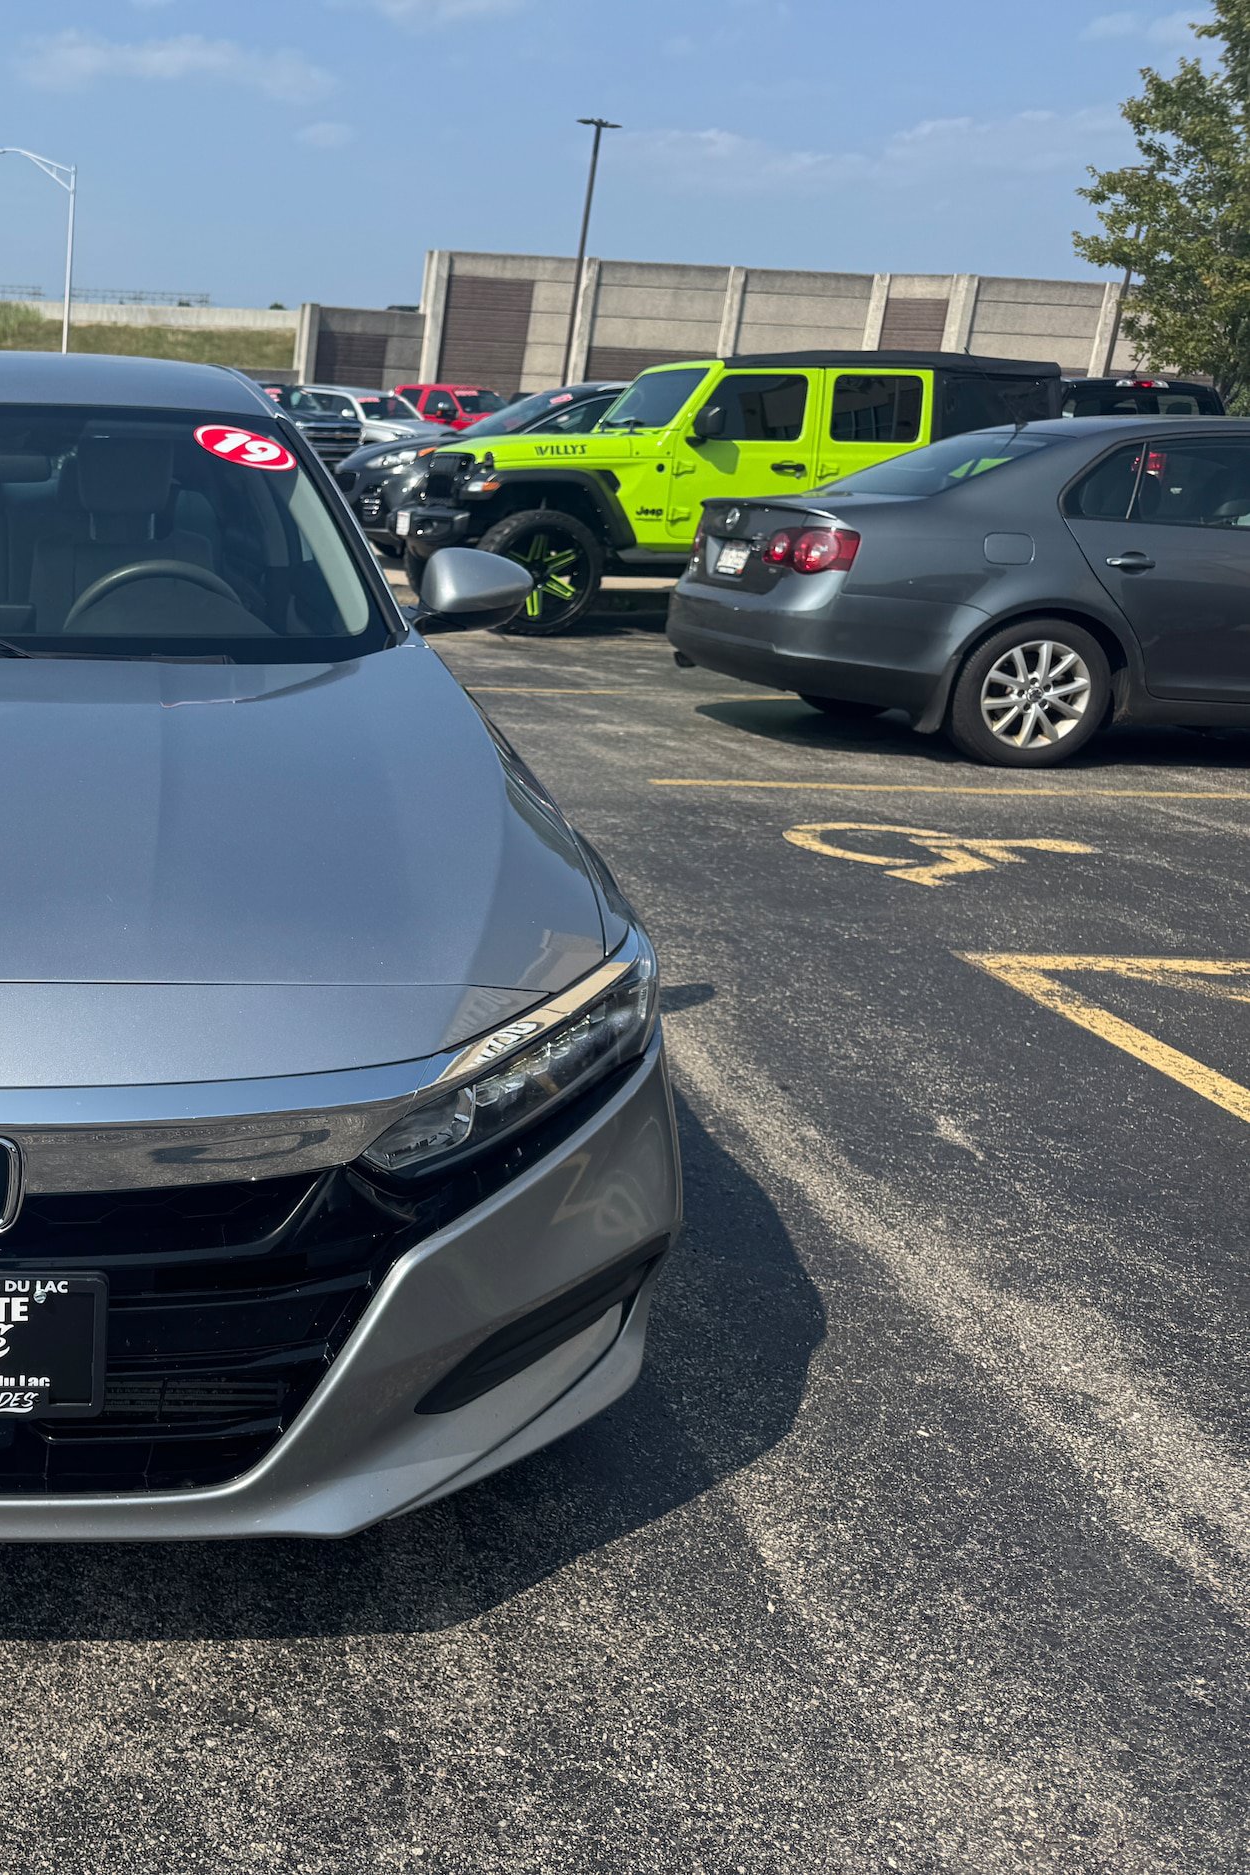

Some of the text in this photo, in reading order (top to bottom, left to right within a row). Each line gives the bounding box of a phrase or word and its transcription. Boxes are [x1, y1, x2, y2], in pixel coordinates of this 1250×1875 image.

[213, 432, 281, 462] 19
[535, 444, 587, 456] WILLYS
[635, 506, 663, 517] Jeep
[4, 1280, 29, 1293] DU
[36, 1280, 68, 1294] LAC
[19, 1374, 50, 1387] Lac
